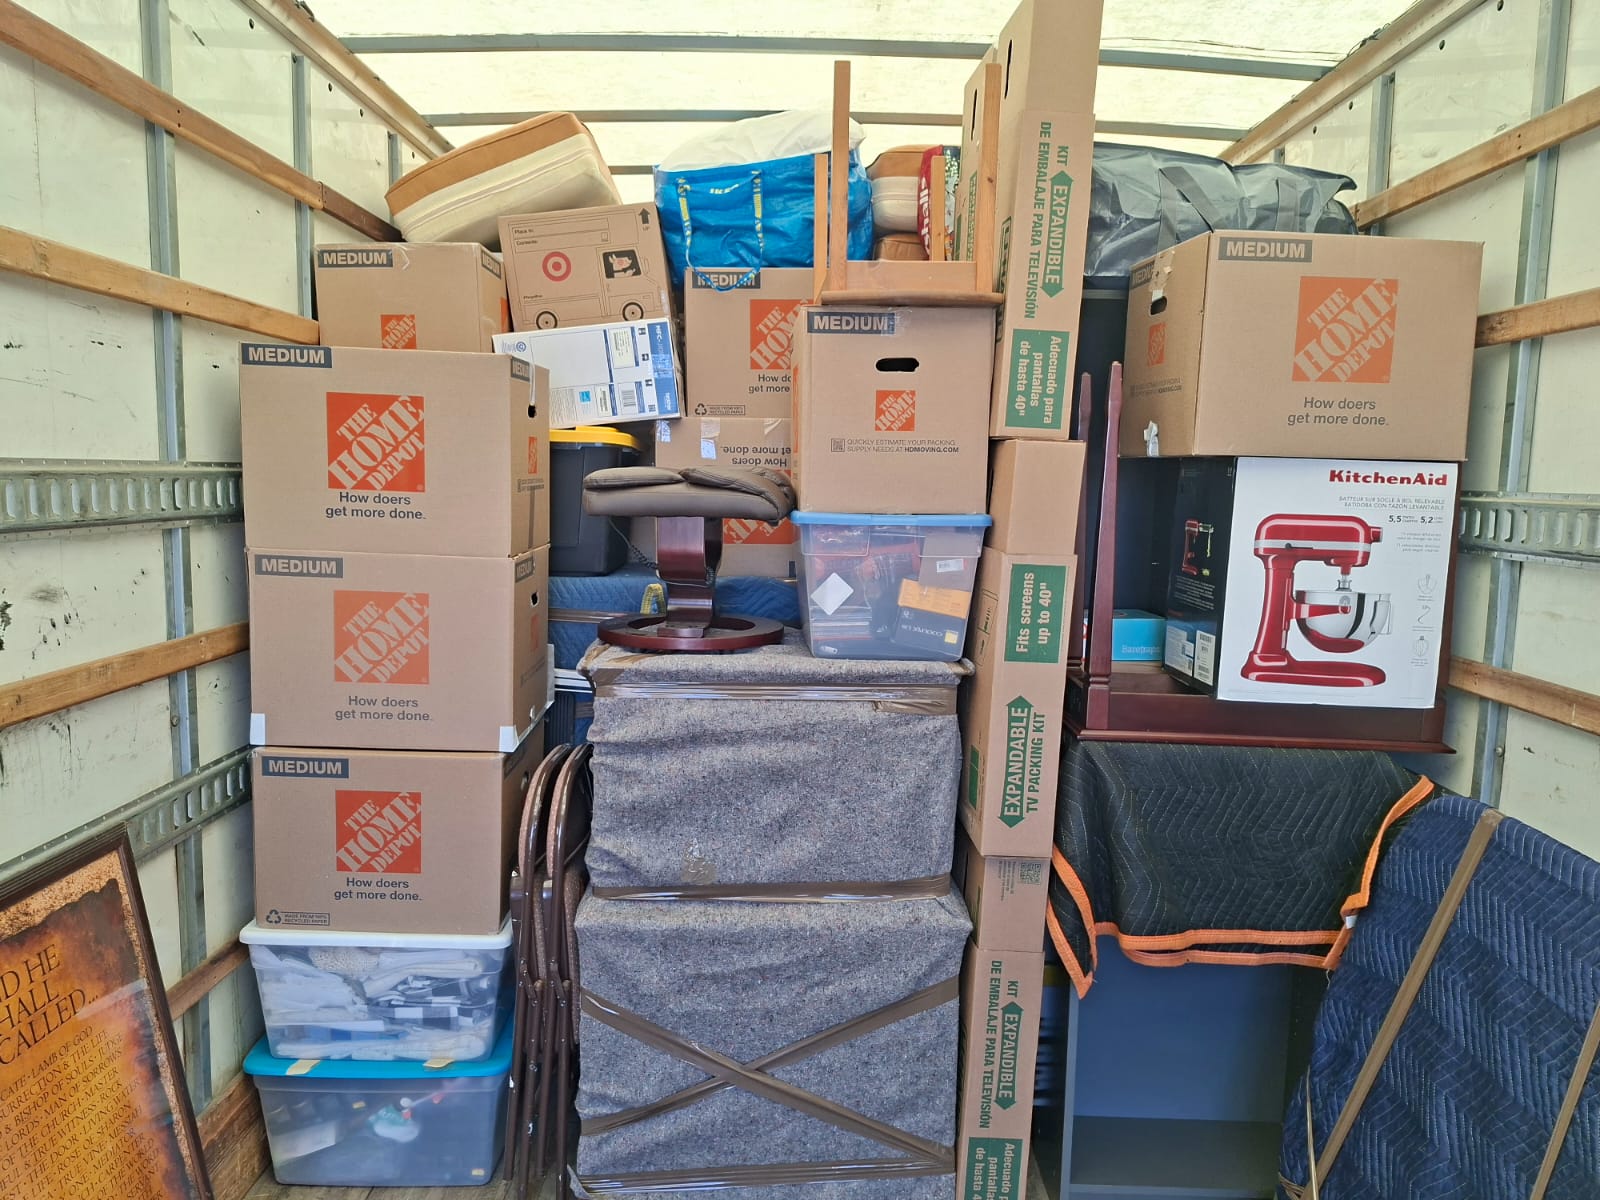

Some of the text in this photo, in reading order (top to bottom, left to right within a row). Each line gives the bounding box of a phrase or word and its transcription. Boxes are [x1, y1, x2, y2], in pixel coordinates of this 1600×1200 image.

[1057, 146, 1069, 166] KIT
[1025, 122, 1051, 318] DE EMBALAJE PARA TELEVISIÓN
[1045, 185, 1068, 283] EXPANDIBLE
[324, 253, 386, 264] MEDIUM
[1227, 241, 1305, 258] MEDIUM
[756, 306, 784, 335] THE
[814, 316, 888, 330] MEDIUM
[1307, 288, 1350, 329] THE
[383, 316, 415, 348] HOME
[1295, 278, 1399, 382] HOME
[1332, 319, 1394, 382] DEPOT
[248, 346, 325, 364] MEDIUM
[749, 385, 763, 394] get
[758, 374, 778, 382] How
[1015, 341, 1031, 416] de hasta 40"
[1030, 352, 1043, 406] pantallas
[1044, 336, 1062, 423] Adecuado para
[876, 391, 916, 431] HOME
[880, 394, 896, 410] THE
[891, 407, 915, 431] DEPOT
[1288, 413, 1389, 426] get more done.
[1304, 398, 1375, 410] How doers
[328, 395, 425, 488] HOME
[336, 404, 378, 442] THE
[365, 432, 425, 490] DEPOT
[720, 446, 749, 454] done.
[732, 458, 787, 467] How doers
[780, 446, 791, 454] et
[340, 492, 410, 505] How doers
[1329, 470, 1448, 486] KitchenAid
[326, 506, 426, 520] get more done.
[262, 558, 336, 575] MEDIUM
[342, 601, 384, 638] THE
[1015, 572, 1035, 653] Fits screens
[1038, 582, 1052, 644] up to 40"
[334, 593, 429, 682] HOME
[371, 628, 429, 683] DEPOT
[335, 709, 432, 721] get more done.
[348, 696, 418, 708] How doers
[268, 759, 342, 775] MEDIUM
[1004, 707, 1028, 817] EXPANDABLE
[1026, 712, 1045, 813] TV PACKING KIT
[336, 792, 422, 872] HOME
[344, 800, 380, 832] THE
[370, 822, 422, 872] DEPOT
[334, 889, 422, 901] get more done.
[346, 878, 409, 888] How doers
[0, 944, 61, 1000] D HE
[1007, 980, 1018, 998] KIT
[30, 1050, 58, 1078] LAMB
[58, 1040, 71, 1056] OF
[72, 1025, 91, 1045] GOD
[62, 1059, 69, 1069] &
[71, 1044, 88, 1062] THE
[979, 960, 1002, 1128] DE EMBALAJE PARA TELEVISIÓN
[999, 1014, 1019, 1098] EXPANDIBLE
[4, 1123, 11, 1133] &
[13, 1090, 49, 1126] BISHOP
[51, 1079, 63, 1096] OF
[66, 1056, 93, 1083] SOULS
[5, 1117, 39, 1150] LORDS
[44, 1094, 65, 1118] MAN
[68, 1082, 80, 1098] OF
[83, 1047, 122, 1085] SORROWS
[1, 1153, 15, 1171] OF
[19, 1134, 38, 1156] THE
[40, 1097, 81, 1138] CHURCH
[85, 1065, 118, 1099] MASTER
[34, 1133, 56, 1161] TRUE
[57, 1100, 95, 1138] WITNESS
[99, 1079, 121, 1102] ROCK
[29, 1159, 48, 1182] THE
[49, 1132, 78, 1163] DOOR
[83, 1101, 113, 1134] LIVING
[32, 1174, 52, 1197] LIFE
[57, 1147, 80, 1173] ROSE
[82, 1136, 93, 1150] OF
[97, 1101, 130, 1137] SHARON
[69, 1174, 88, 1196] ONE
[93, 1127, 135, 1173] MEDIATOR
[98, 1132, 144, 1183] CARPENTER
[60, 1161, 83, 1189] TRUE
[85, 1140, 105, 1165] VINE
[110, 1167, 126, 1187] THE
[973, 1148, 986, 1191] de hasta
[1001, 1143, 1016, 1193] Adecuado
